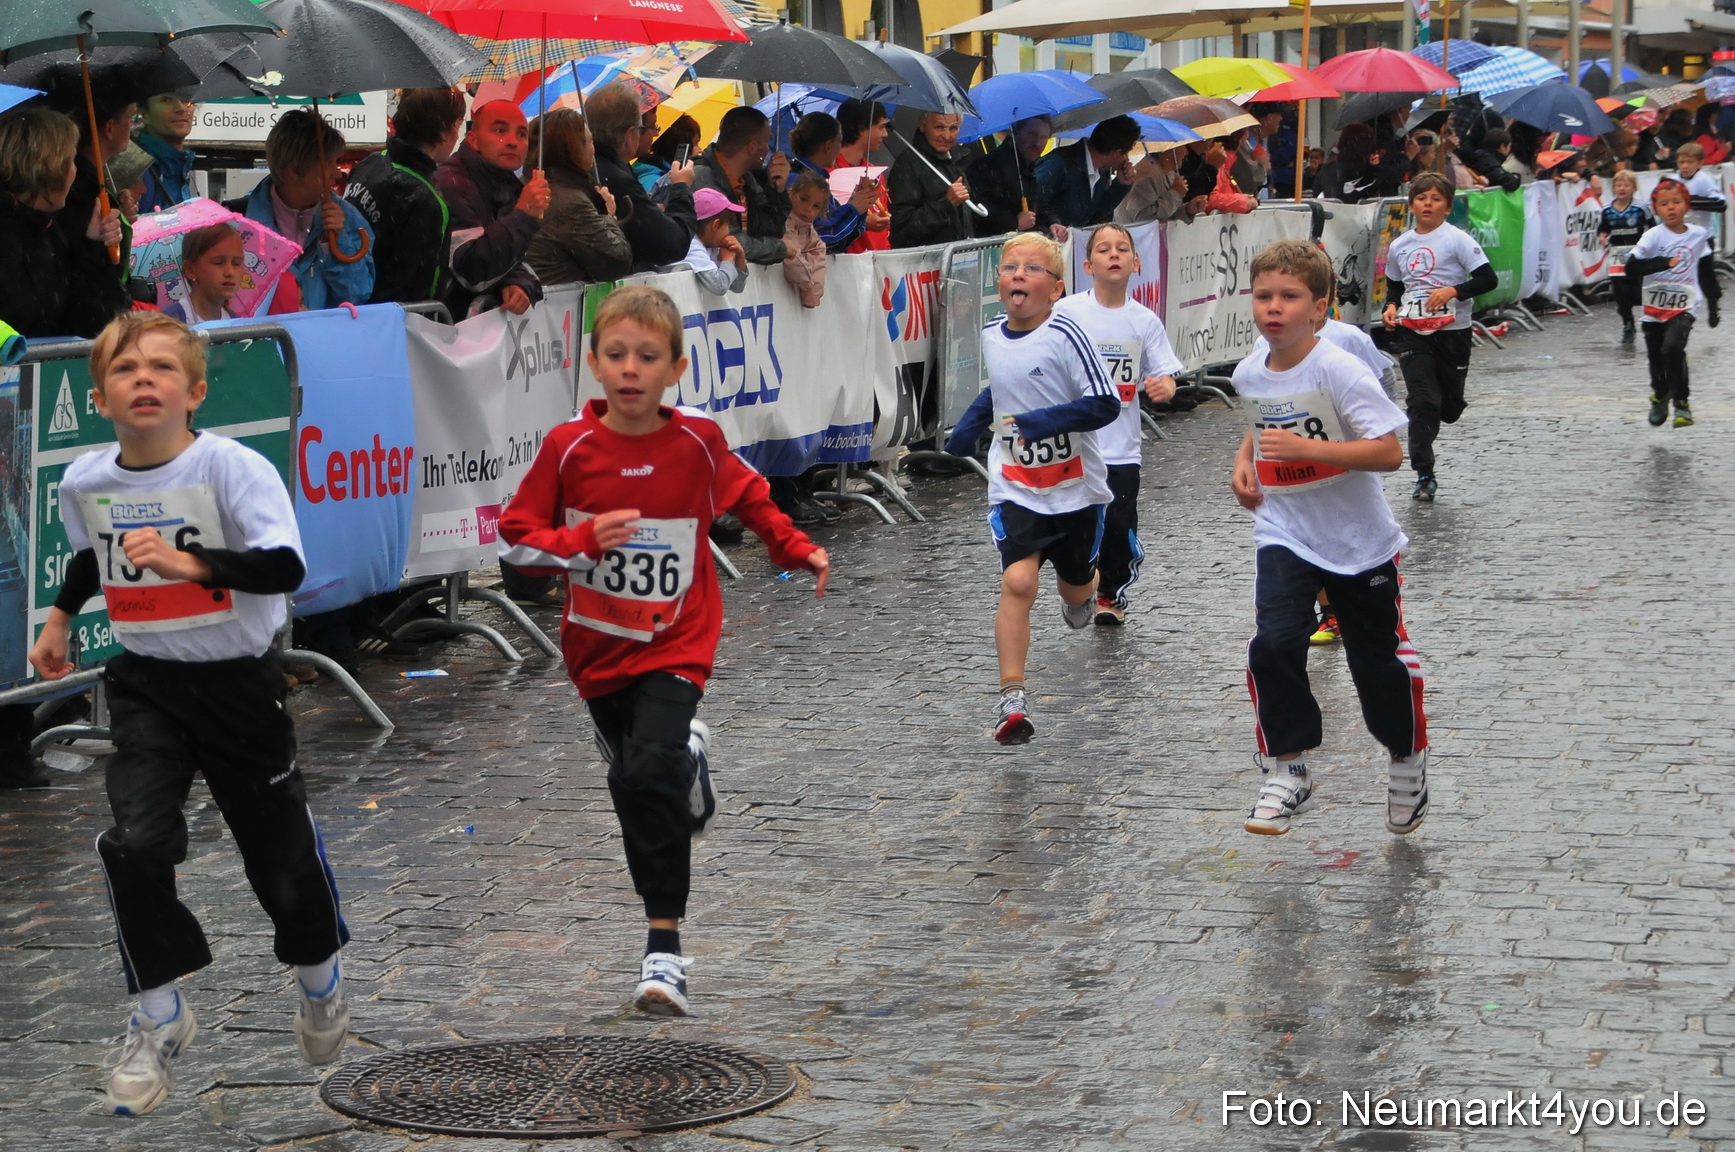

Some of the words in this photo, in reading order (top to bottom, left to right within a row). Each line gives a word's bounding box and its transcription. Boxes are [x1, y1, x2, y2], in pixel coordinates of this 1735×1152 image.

[629, 0, 683, 12] LANGNESE
[203, 112, 265, 127] Gebäude
[325, 113, 366, 129] GmbH
[1179, 252, 1215, 285] RECHTS
[1649, 291, 1688, 308] 7048
[664, 303, 783, 413] OCK
[1260, 401, 1296, 415] BOCK
[1002, 432, 1072, 466] 7359
[298, 425, 414, 504] Center
[422, 454, 447, 489] Ihr
[508, 436, 521, 466] 2x
[523, 432, 533, 463] in
[621, 466, 650, 477] JAKO
[1275, 464, 1316, 483] Kilian
[111, 502, 164, 519] BOCK
